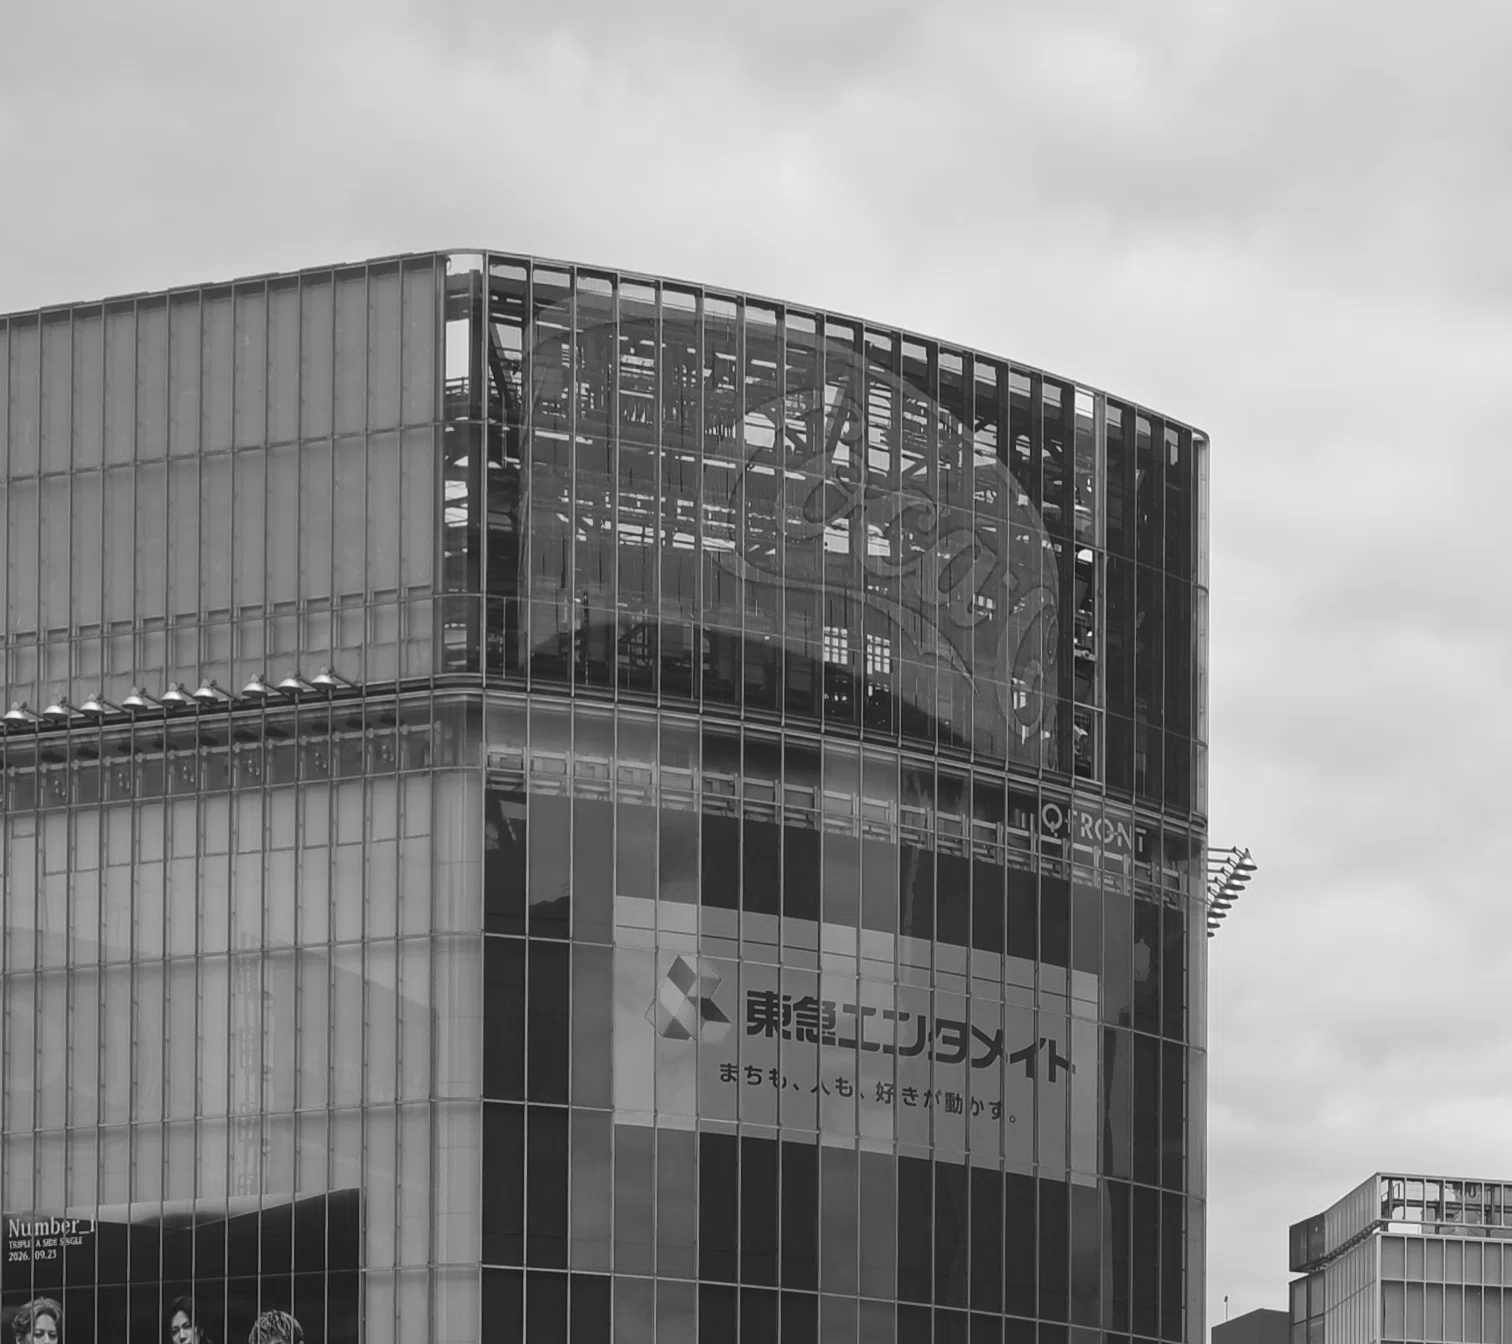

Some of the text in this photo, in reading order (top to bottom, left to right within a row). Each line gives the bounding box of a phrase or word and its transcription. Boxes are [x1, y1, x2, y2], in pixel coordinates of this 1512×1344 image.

[747, 990, 1076, 1083] 東急エンタメイト
